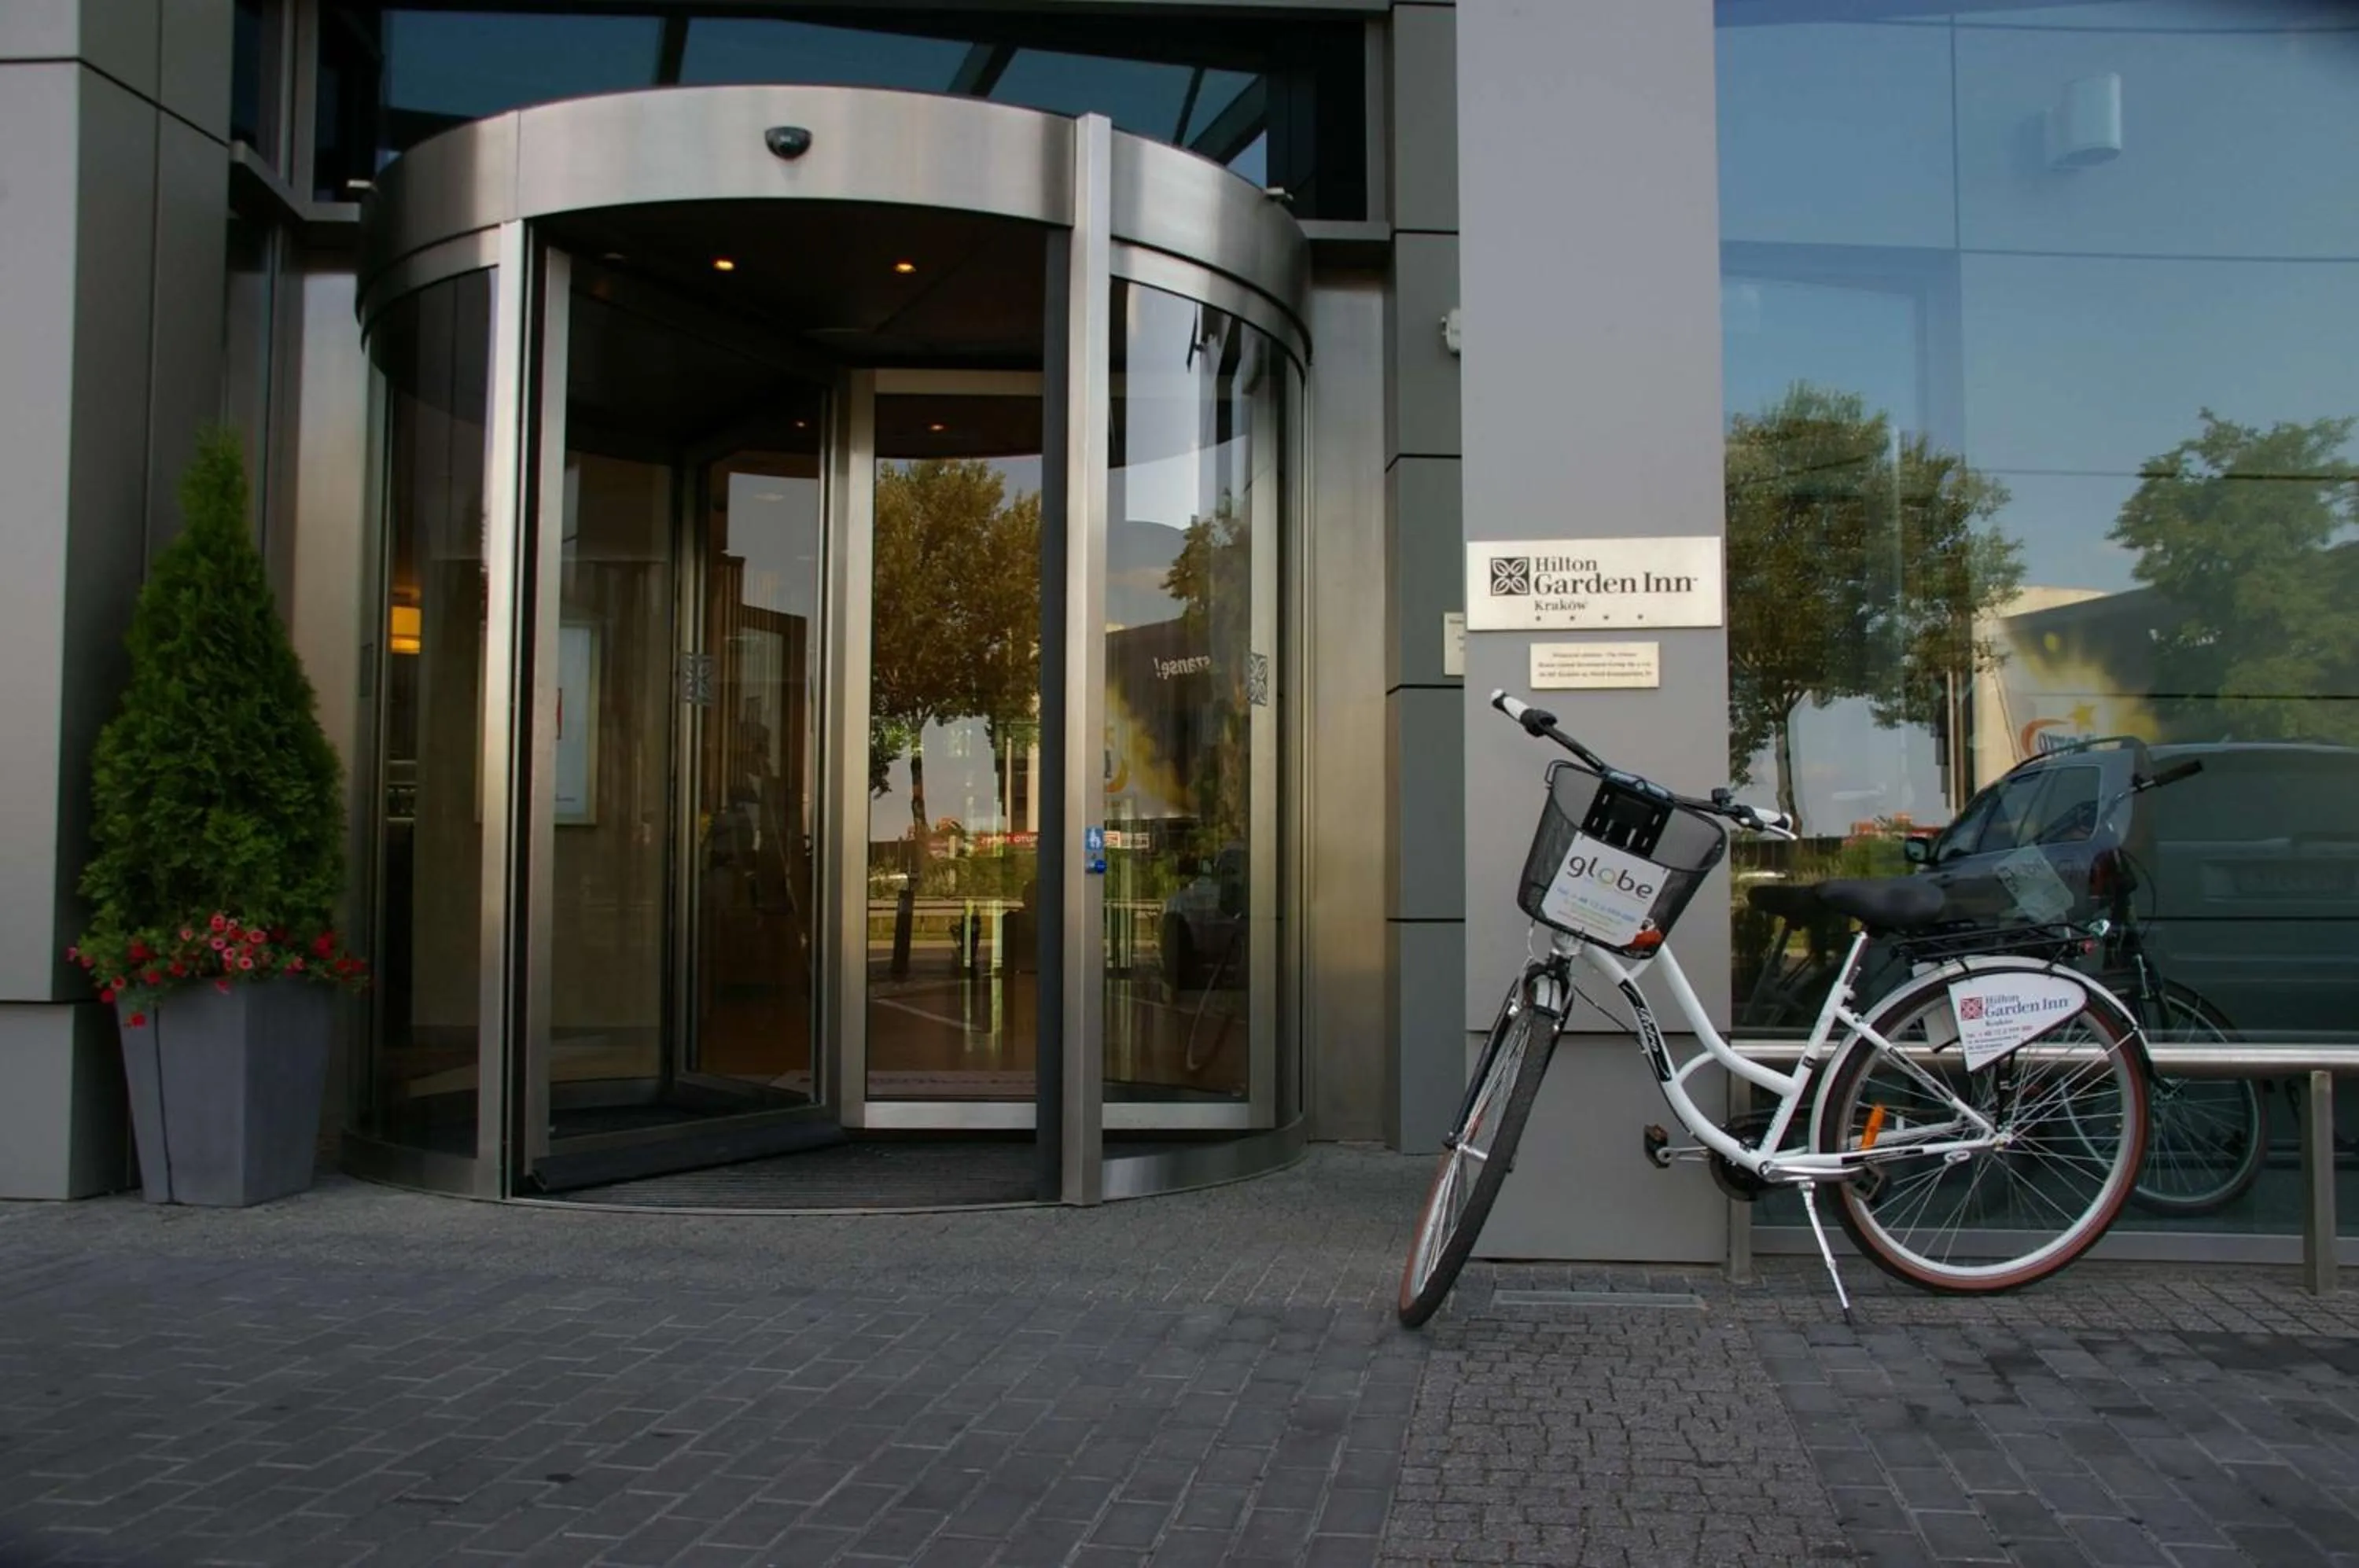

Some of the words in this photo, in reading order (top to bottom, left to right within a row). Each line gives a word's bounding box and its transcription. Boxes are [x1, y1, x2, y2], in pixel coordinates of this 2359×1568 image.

[1535, 556, 1598, 572] Hilton
[1534, 572, 1636, 595] Garden
[1643, 571, 1693, 594] Inn
[1534, 598, 1587, 612] Kraków
[1567, 856, 1653, 899] globe
[1985, 994, 2019, 1004] Hilton
[1985, 1002, 2040, 1018] Garden
[2043, 997, 2069, 1010] Inn
